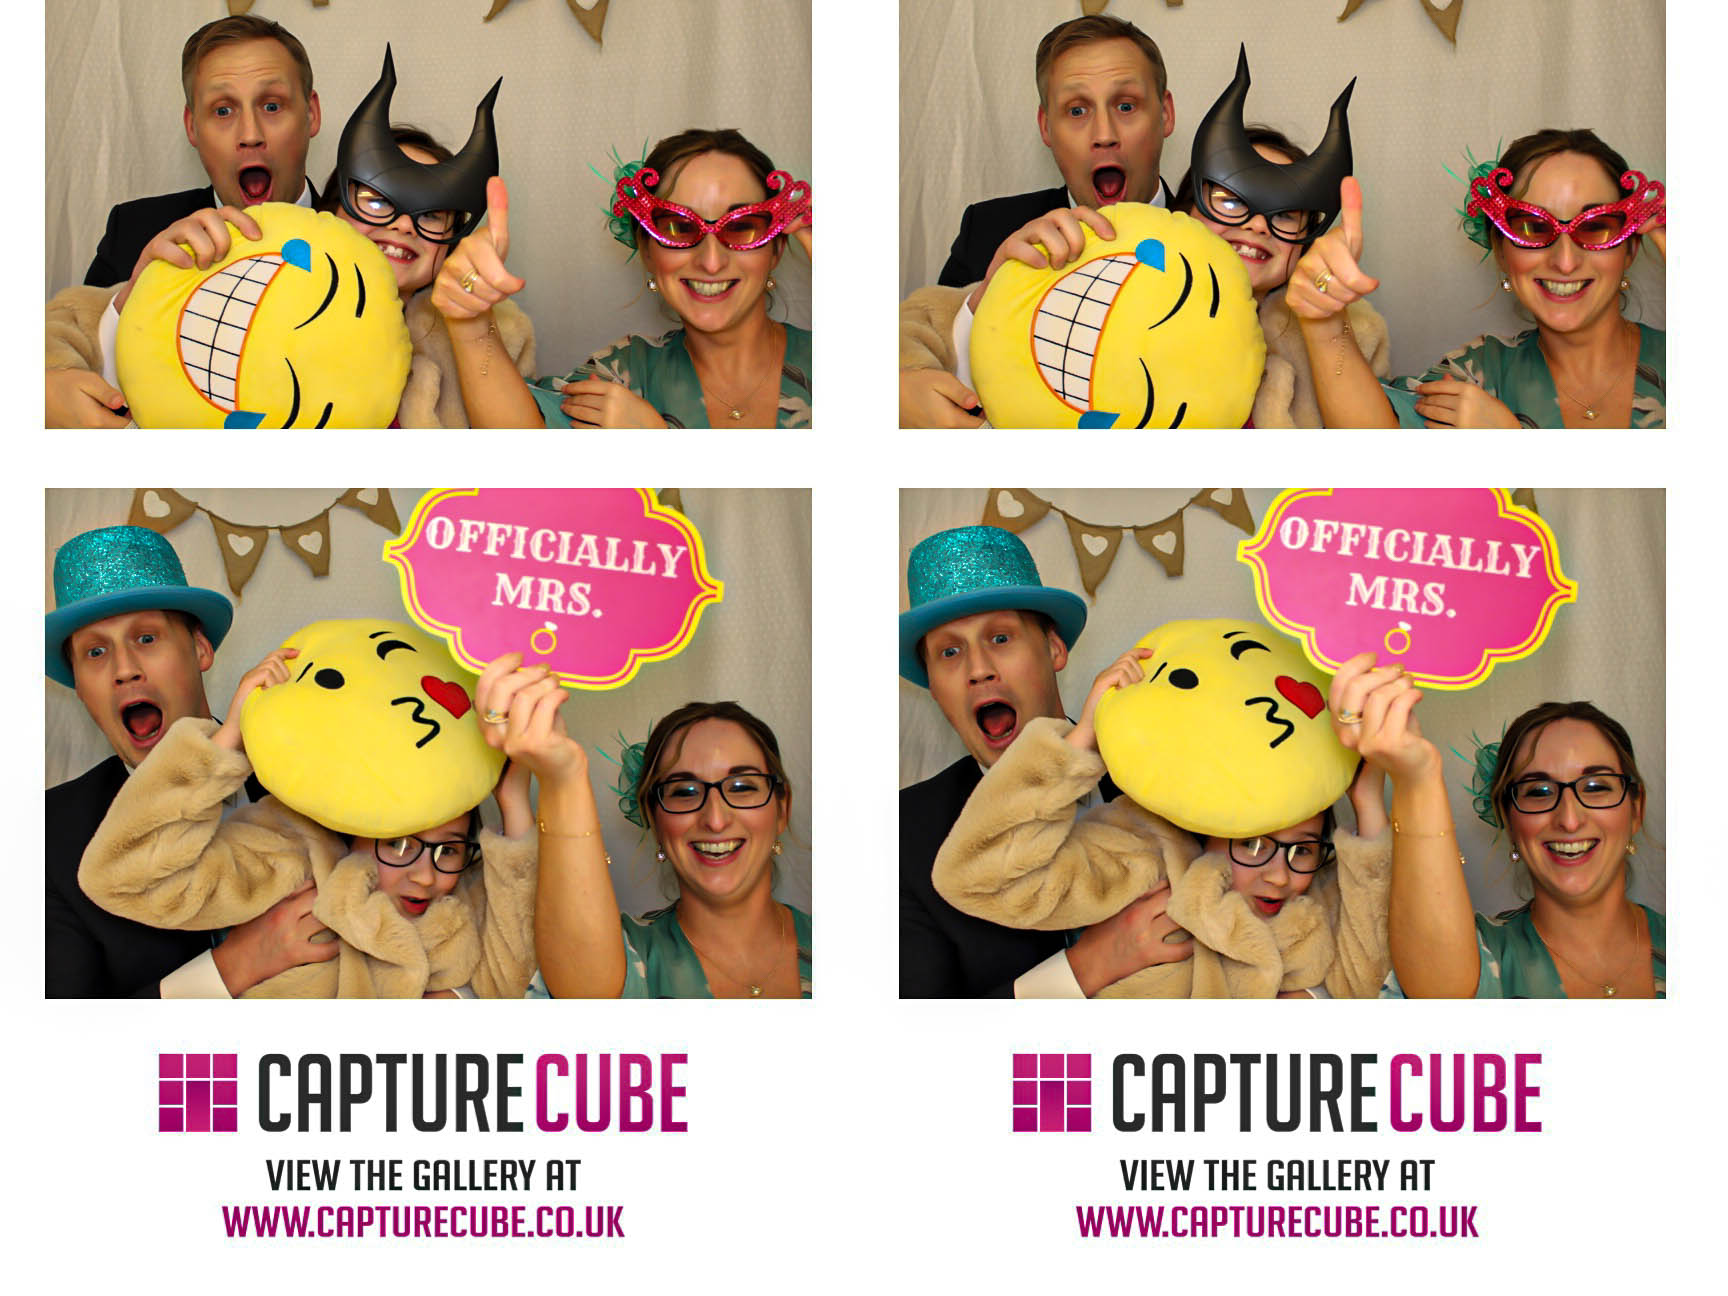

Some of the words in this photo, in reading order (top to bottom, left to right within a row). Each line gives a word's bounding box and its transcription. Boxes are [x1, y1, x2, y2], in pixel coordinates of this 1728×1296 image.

[425, 515, 688, 579] OFFICIALLY
[1279, 515, 1542, 579] OFFICIALLY
[491, 572, 603, 619] MRS.
[1345, 572, 1457, 619] MRS.
